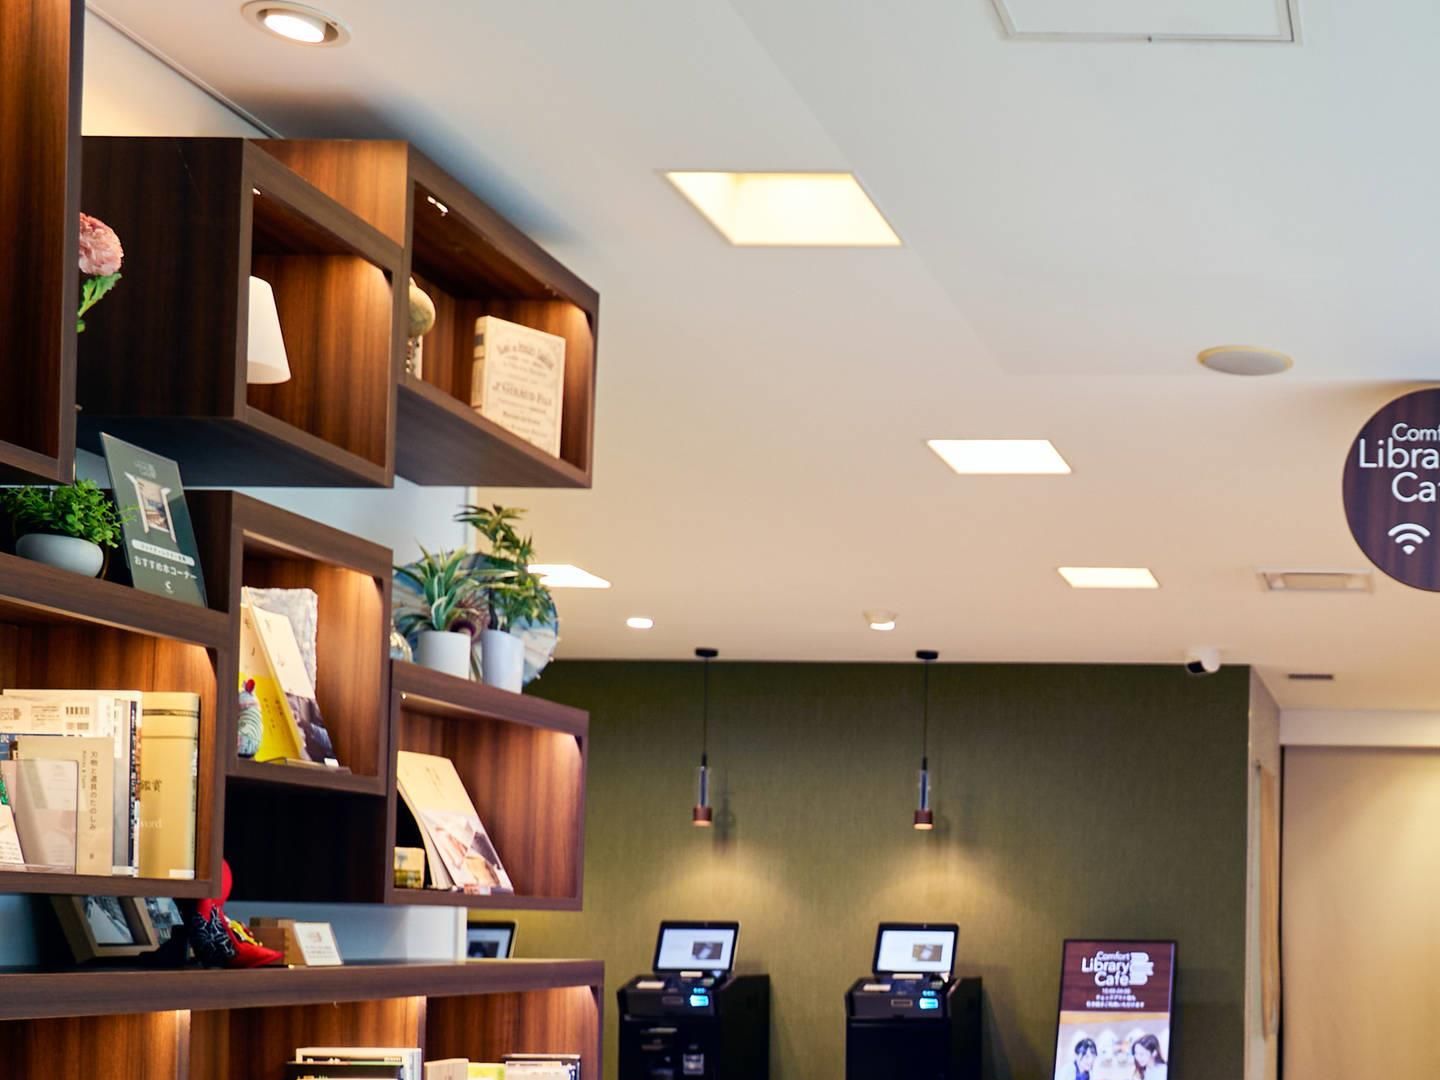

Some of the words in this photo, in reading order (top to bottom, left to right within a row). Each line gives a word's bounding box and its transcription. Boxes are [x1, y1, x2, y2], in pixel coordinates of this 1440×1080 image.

[1096, 951, 1131, 961] Comfort
[1081, 957, 1130, 975] Library
[1095, 972, 1130, 987] Cafe
